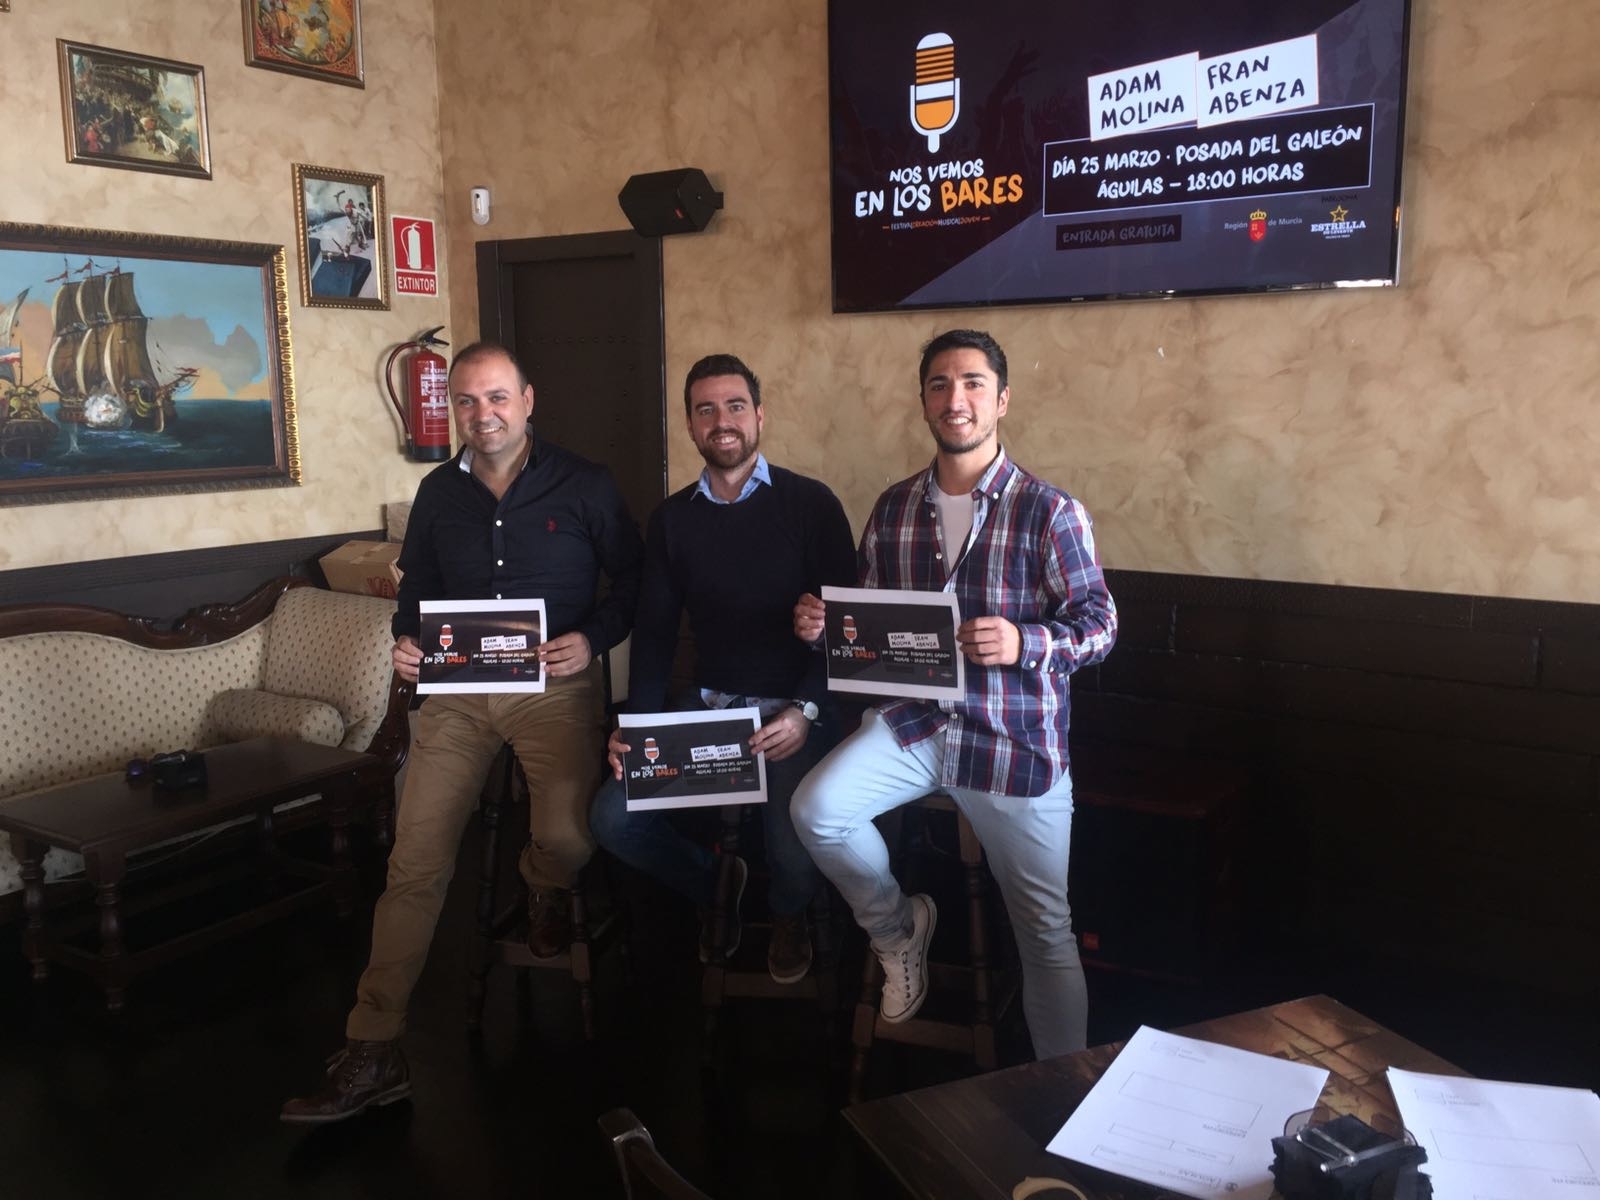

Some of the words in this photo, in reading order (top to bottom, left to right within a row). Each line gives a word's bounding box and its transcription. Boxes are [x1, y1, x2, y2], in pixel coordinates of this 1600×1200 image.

[1100, 69, 1161, 102] ADAM
[1207, 55, 1270, 90] FRAN
[1101, 95, 1185, 130] MOLINA
[1209, 78, 1305, 115] ABENZA
[1052, 155, 1076, 179] DÍA
[1080, 156, 1100, 174] 25
[1104, 149, 1161, 171] MARZO
[1175, 140, 1243, 166] POSADA
[1249, 134, 1281, 157] DEL
[1287, 124, 1362, 152] GALEÓN
[889, 165, 922, 184] NOS
[927, 158, 984, 183] VEMOS
[1097, 176, 1164, 199] ÁGUILAS
[1187, 169, 1236, 191] 18:00
[1241, 162, 1305, 186] HORAS
[855, 190, 885, 218] EN
[893, 184, 932, 217] LOS
[940, 174, 1023, 213] BARES
[1062, 228, 1115, 244] ENTRADA
[1120, 223, 1175, 241] GRATUITA
[1224, 221, 1248, 231] Región
[1268, 218, 1277, 226] de
[1278, 217, 1303, 226] Murcia
[1310, 220, 1366, 232] ESTRELLA
[397, 276, 435, 292] EXTINTOR
